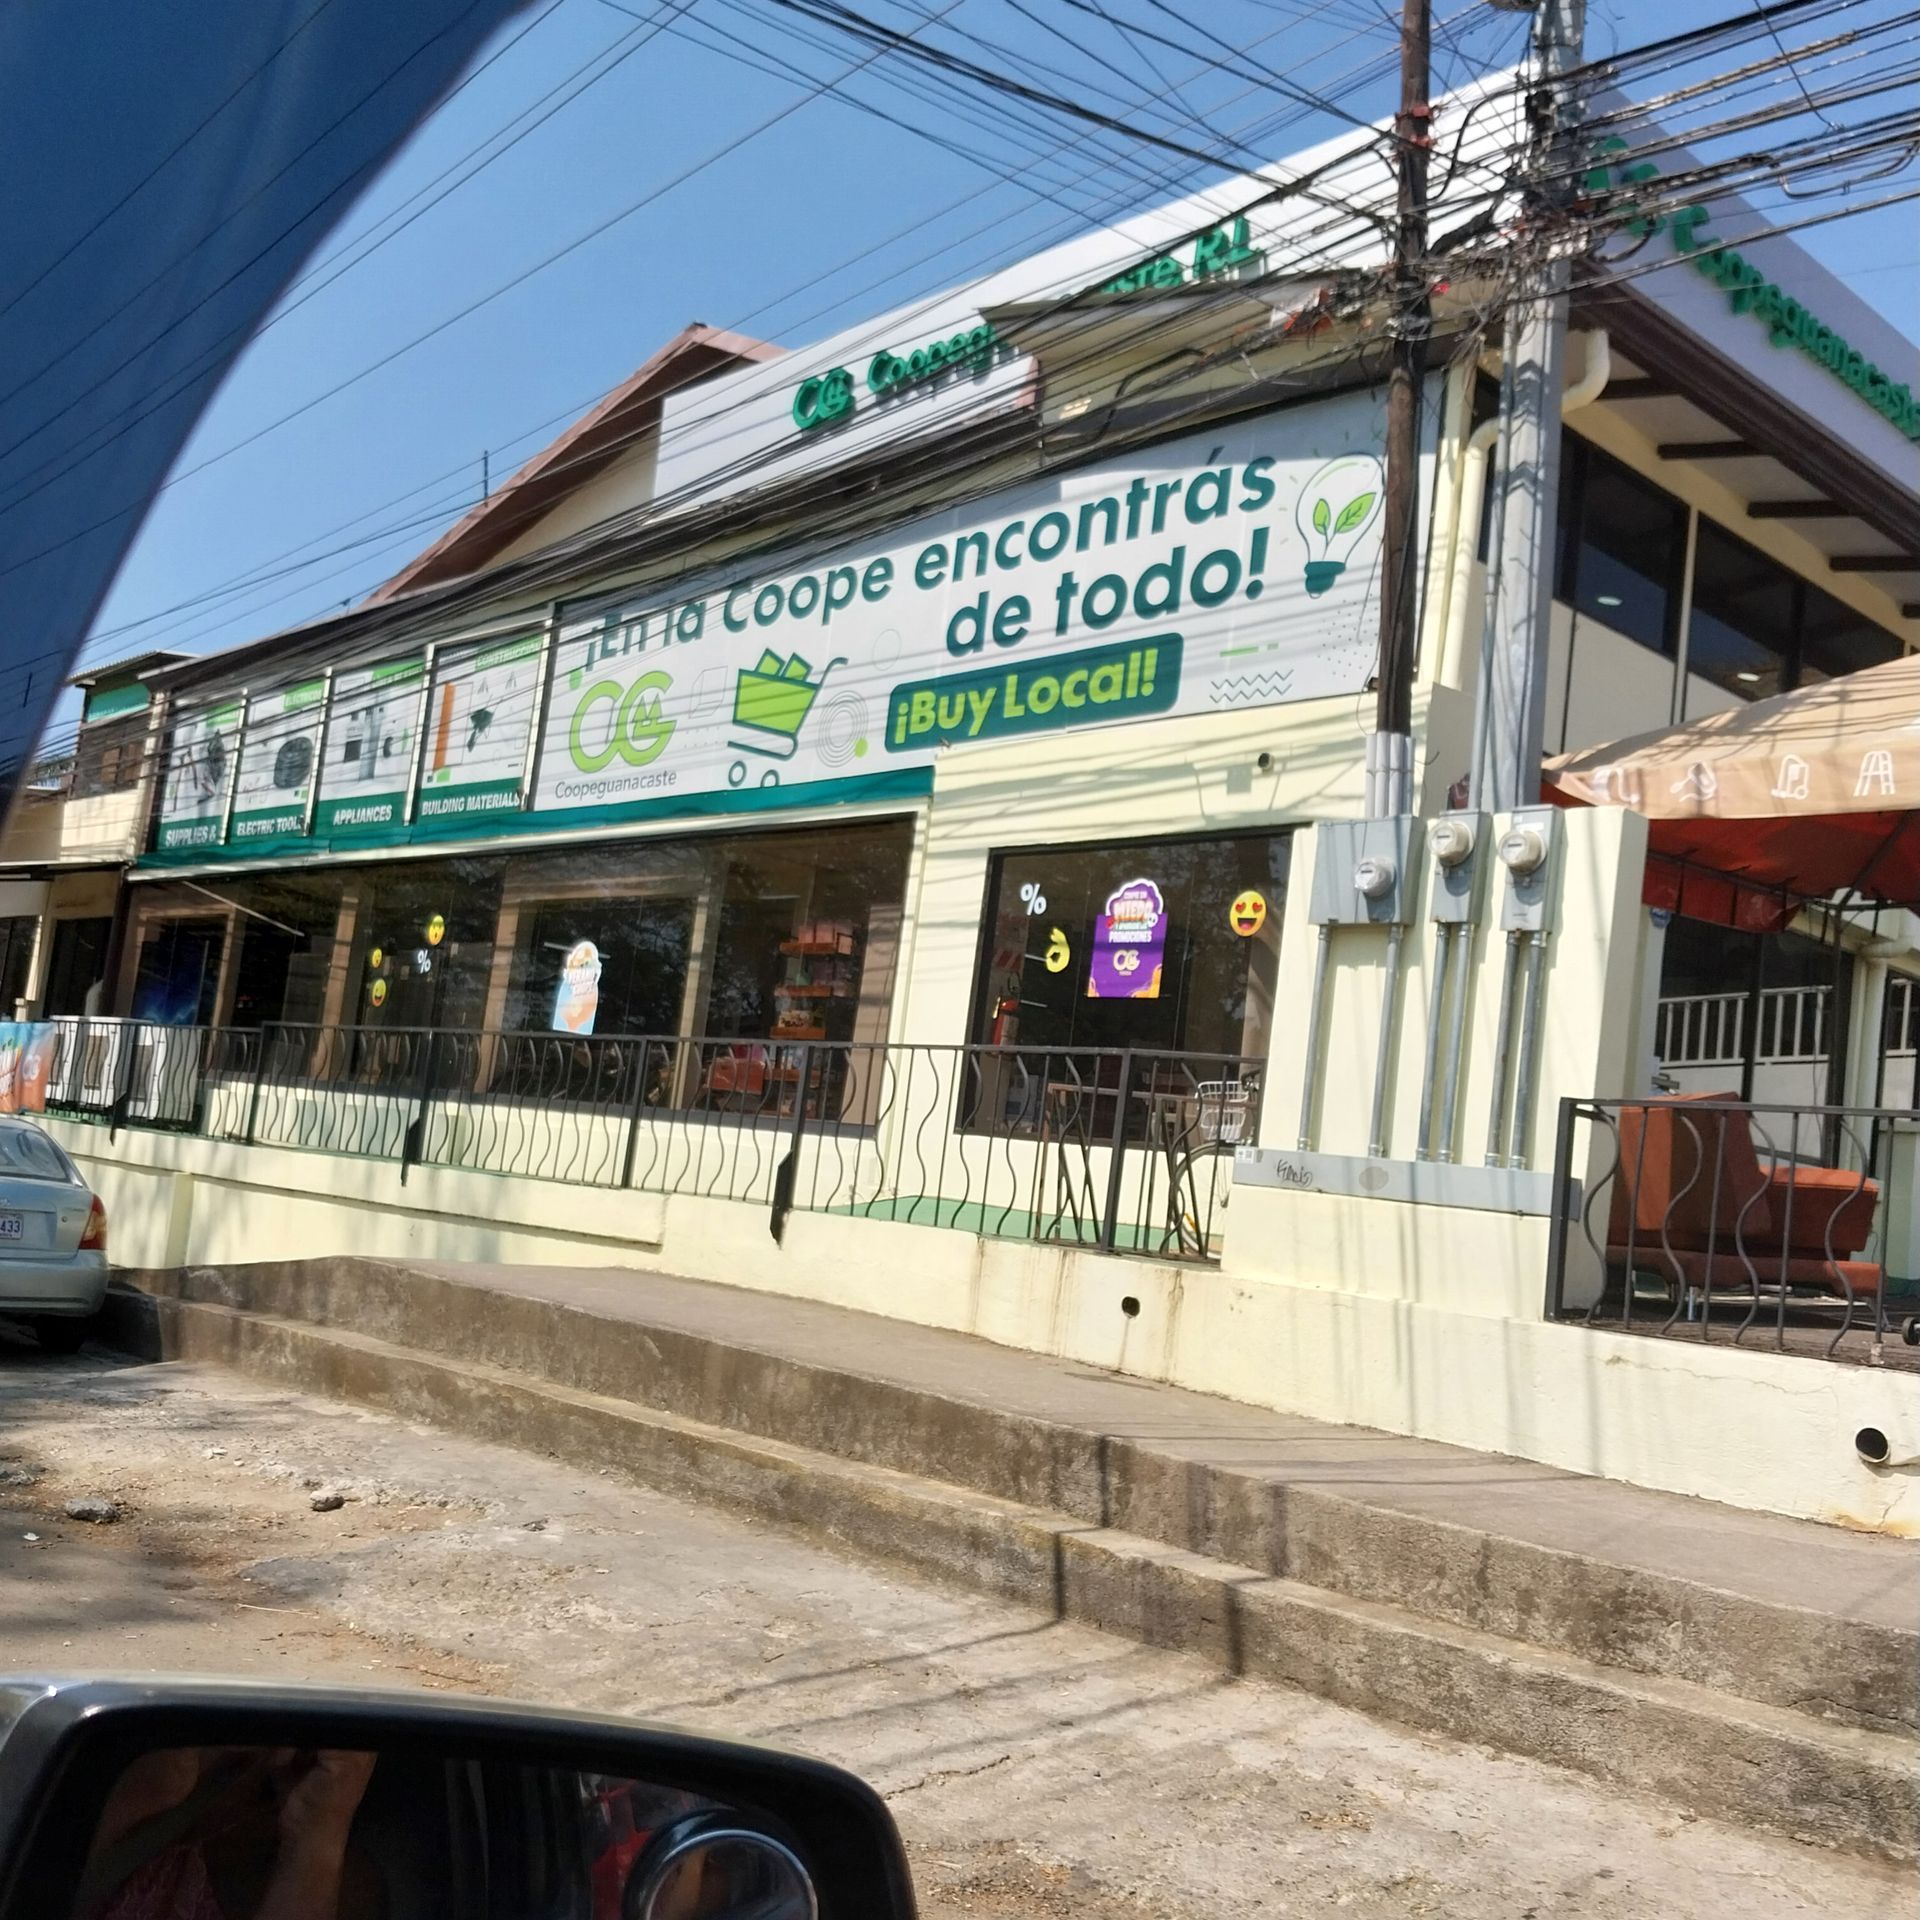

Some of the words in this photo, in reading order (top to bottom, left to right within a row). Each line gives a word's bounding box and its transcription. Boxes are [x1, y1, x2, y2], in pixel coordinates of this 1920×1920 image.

[722, 557, 895, 627] Coope
[915, 446, 1278, 591] encontrás
[946, 591, 1032, 658] de
[1055, 526, 1271, 637] todo!
[893, 687, 998, 745] ¡Buy
[1002, 647, 1159, 719] Local!
[554, 768, 678, 801] Coopeguanacaste
[333, 804, 394, 826] APPLIANCES
[421, 797, 466, 816] BUILDING
[466, 791, 521, 812] MATERIALS
[165, 825, 208, 847] SUPPLIES
[236, 820, 275, 837] ELECTRIC
